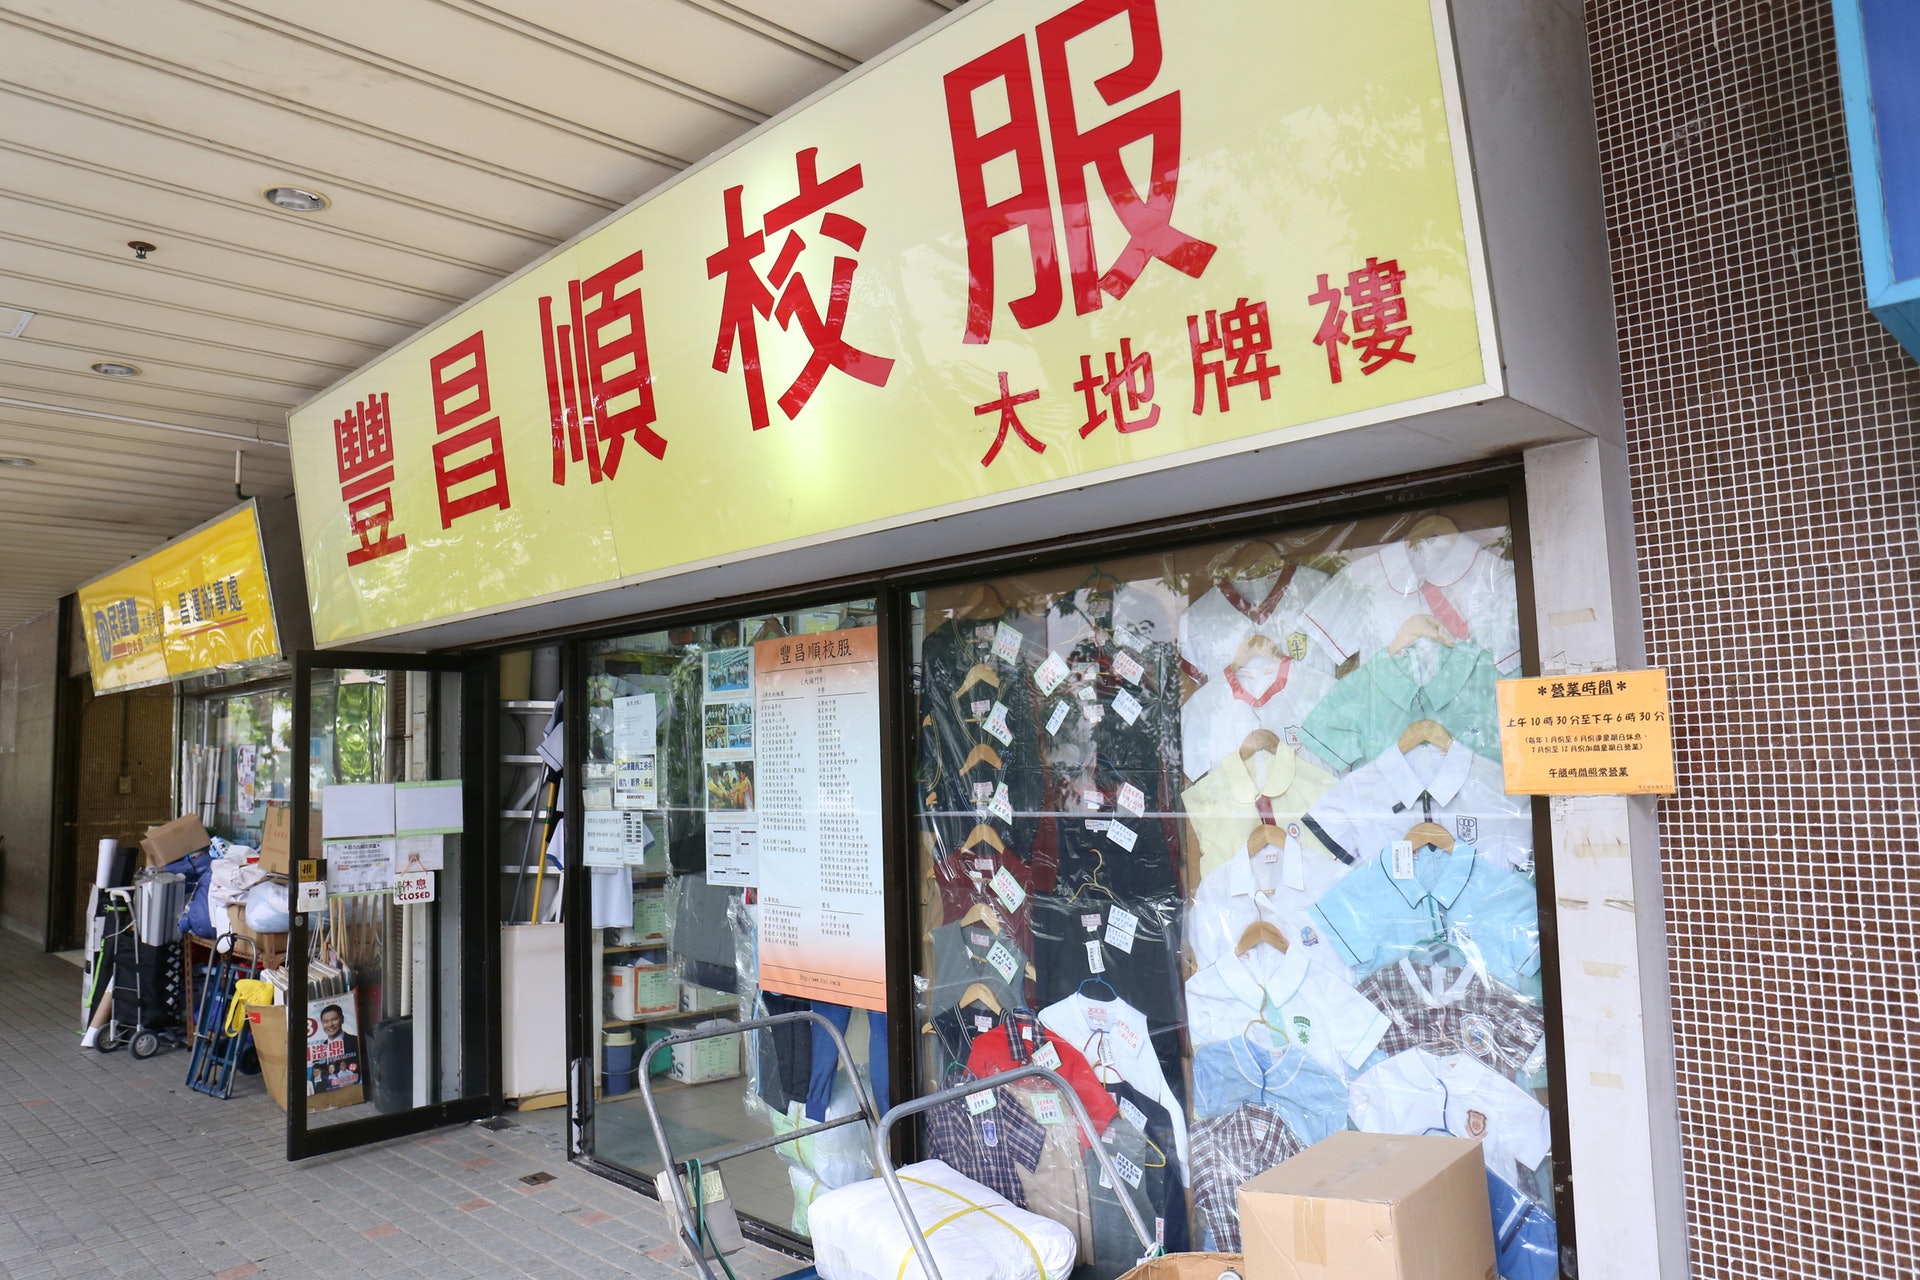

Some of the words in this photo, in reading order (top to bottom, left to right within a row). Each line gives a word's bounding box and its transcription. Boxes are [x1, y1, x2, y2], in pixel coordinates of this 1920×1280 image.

[333, 0, 1217, 567] 豐昌順校服
[973, 257, 1417, 467] 大地牌褸
[126, 638, 144, 656] DAB
[779, 638, 852, 666] 豐昌順校服
[1551, 680, 1614, 698] 營業時間
[397, 891, 431, 901] CLOSED
[307, 1041, 344, 1062] 浩鼎
